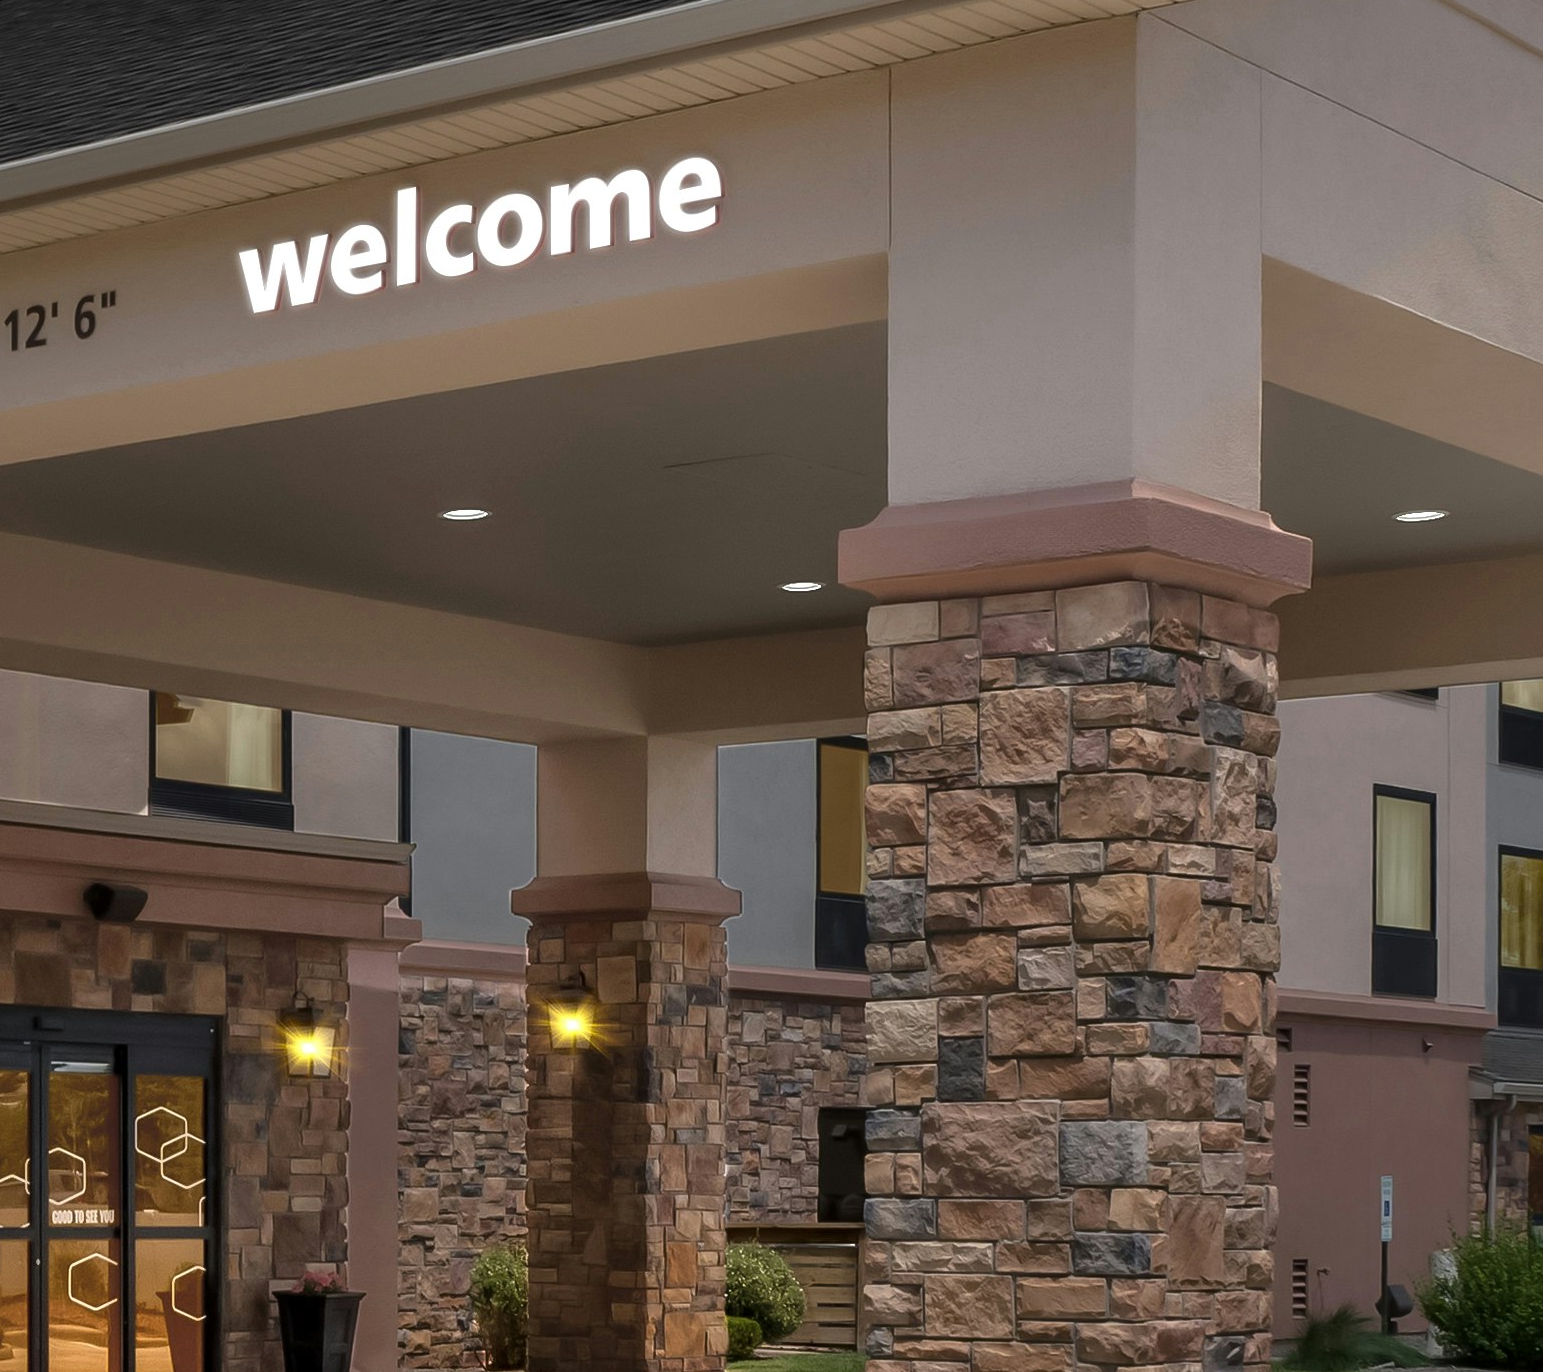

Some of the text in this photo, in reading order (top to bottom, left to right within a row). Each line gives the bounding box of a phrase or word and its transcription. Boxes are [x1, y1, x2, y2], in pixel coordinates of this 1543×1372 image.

[238, 156, 724, 315] welcome
[4, 301, 59, 352] 12'
[74, 290, 117, 340] 6"
[51, 1209, 115, 1224] GOOD TO SEE YOU
